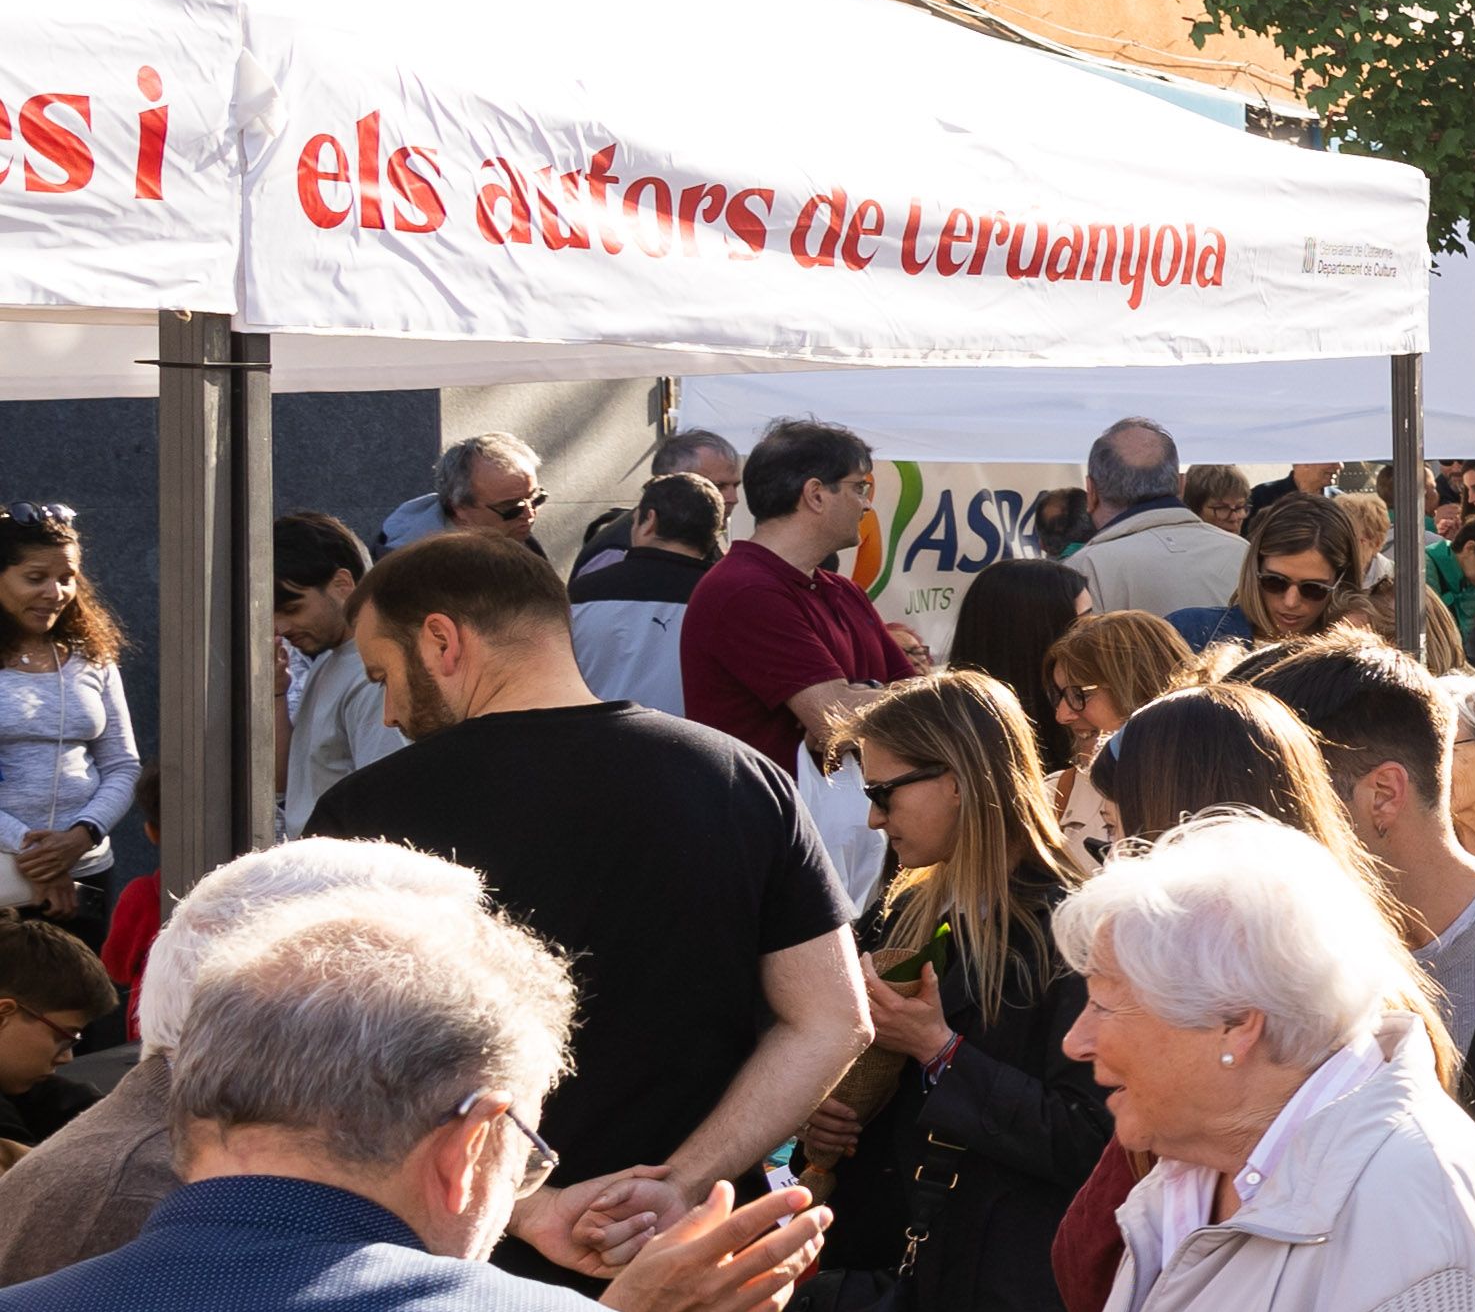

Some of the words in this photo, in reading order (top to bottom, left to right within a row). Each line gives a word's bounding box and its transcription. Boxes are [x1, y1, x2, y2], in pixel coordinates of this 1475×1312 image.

[0, 93, 95, 193] s
[135, 65, 169, 201] i
[297, 109, 447, 234] els
[477, 144, 776, 260] autors
[789, 185, 885, 271] de
[905, 587, 954, 615] JUNTS
